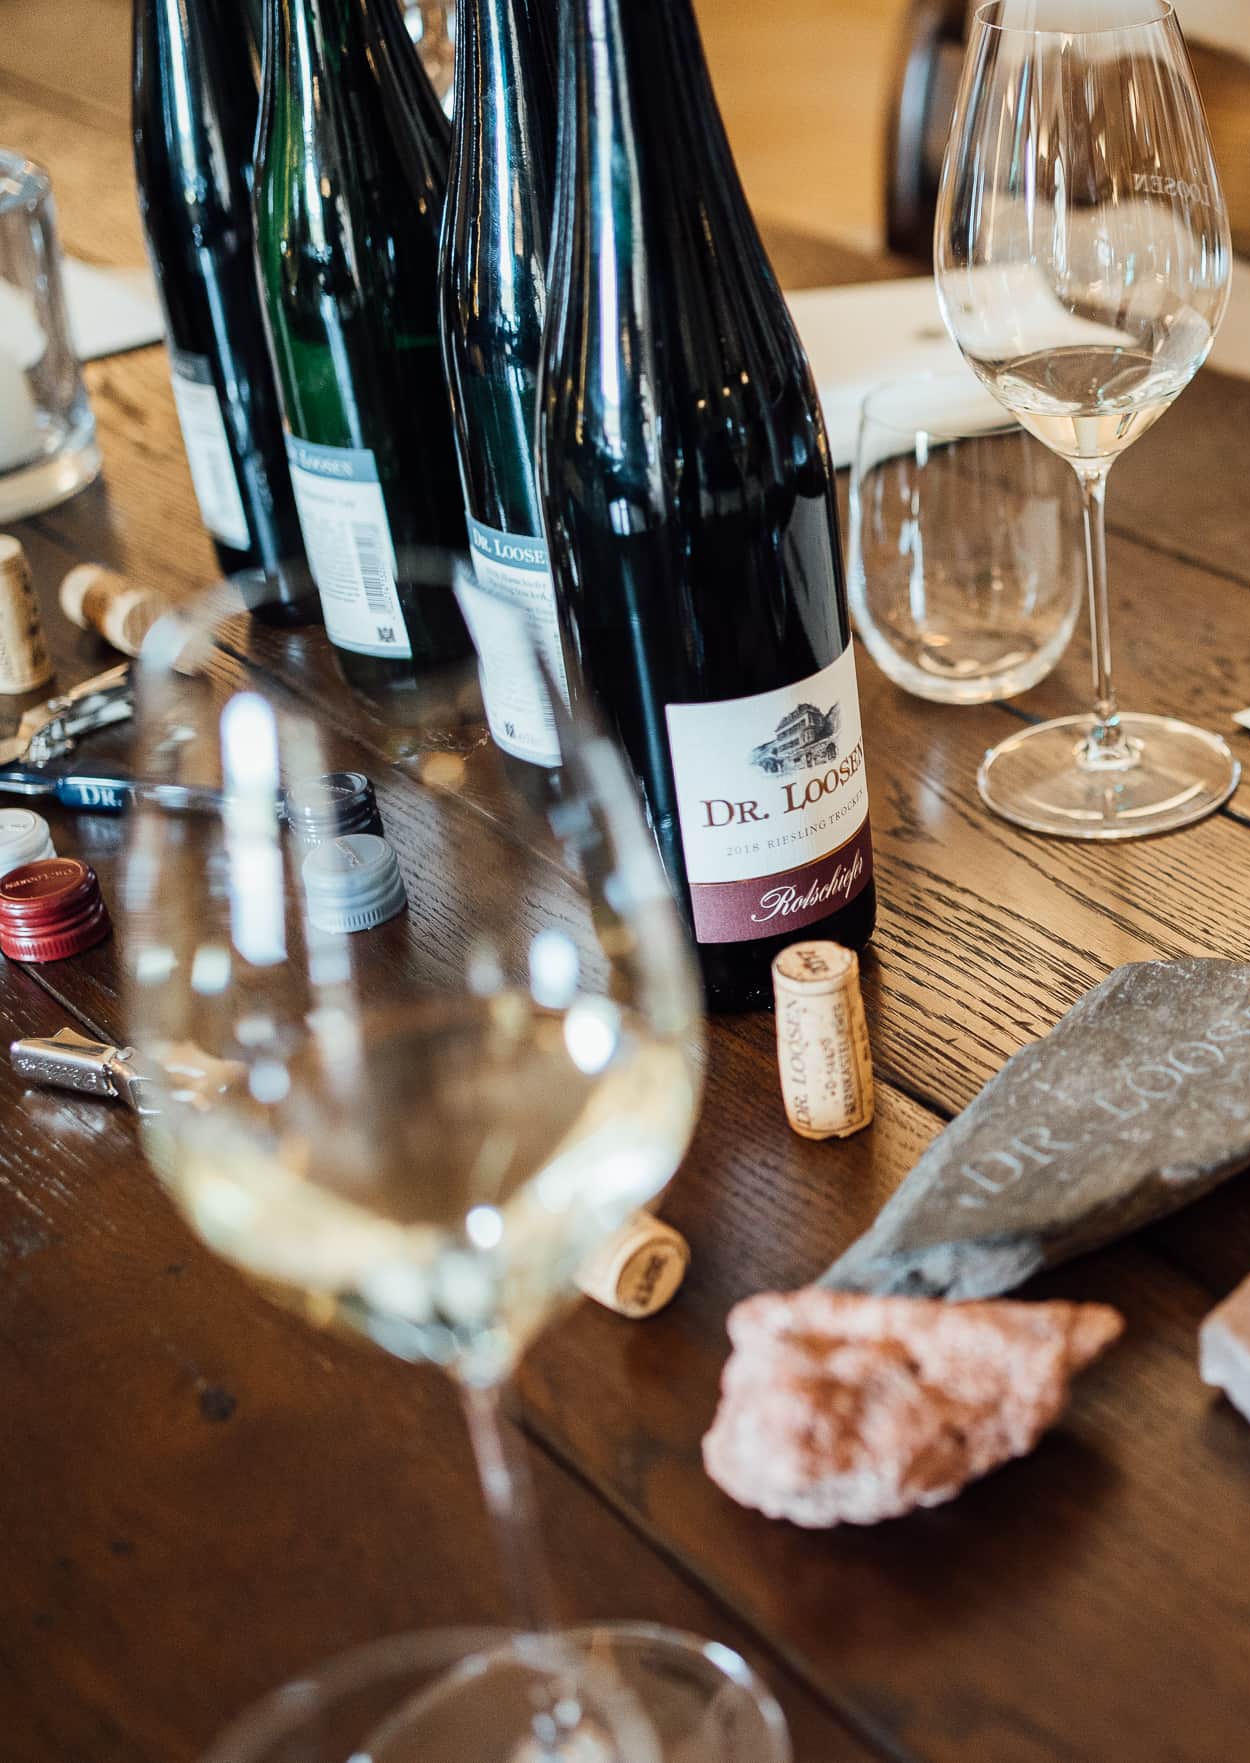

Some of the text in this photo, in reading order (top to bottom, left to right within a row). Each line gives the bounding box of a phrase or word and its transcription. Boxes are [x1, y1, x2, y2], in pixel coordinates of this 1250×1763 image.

[494, 539, 549, 564] LOOSE
[700, 735, 863, 829] DR. LOOSEN
[726, 843, 760, 857] 2018
[767, 817, 827, 850] RIESLING
